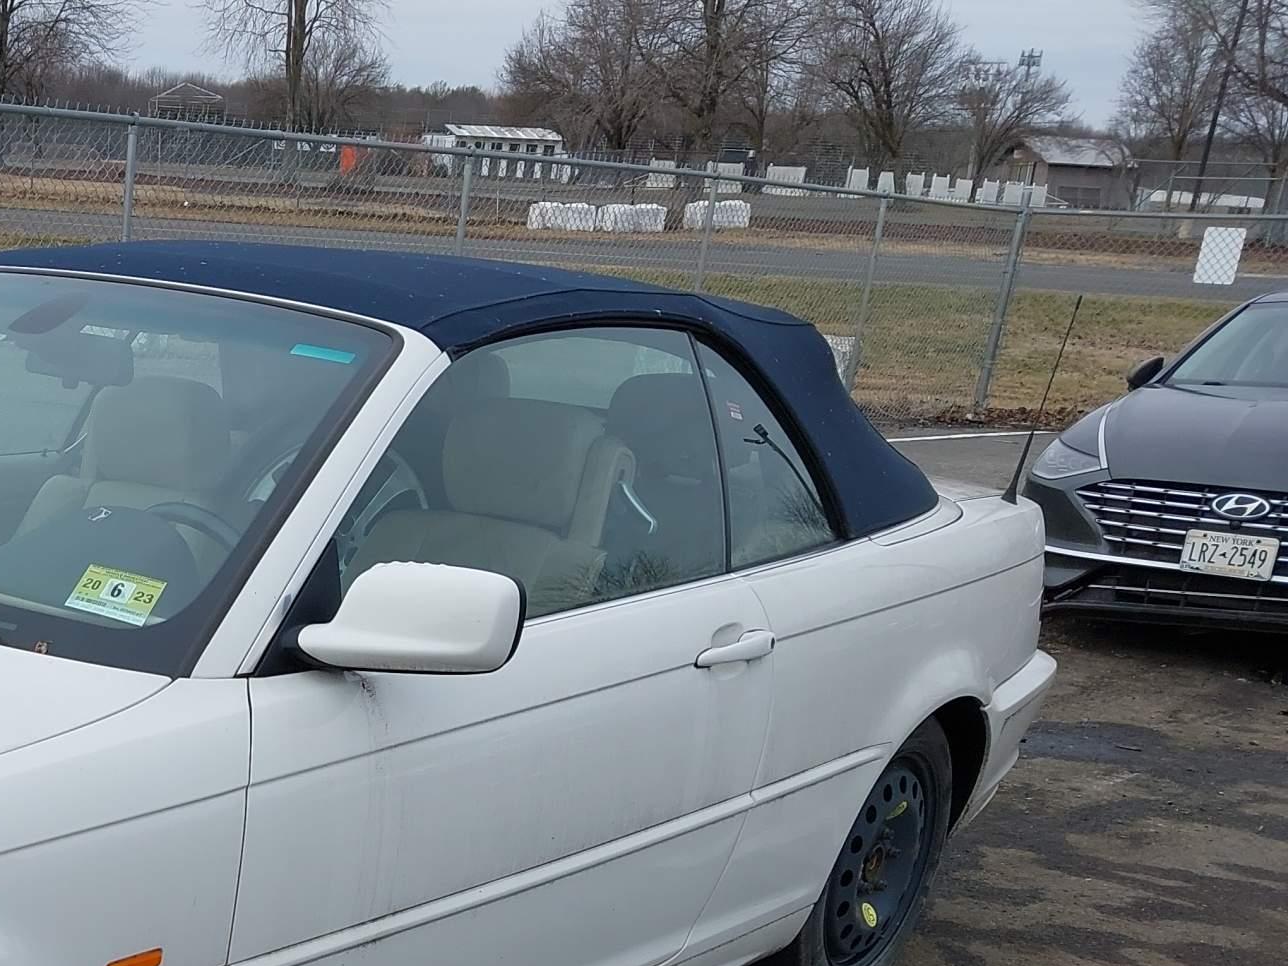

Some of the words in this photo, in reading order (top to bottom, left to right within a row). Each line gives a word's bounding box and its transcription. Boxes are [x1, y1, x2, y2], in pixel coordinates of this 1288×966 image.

[1208, 535, 1231, 544] NEW
[1232, 537, 1254, 547] YORK
[1188, 541, 1220, 564] LRZ
[1227, 545, 1269, 569] 2549
[82, 577, 102, 591] 20
[110, 582, 126, 599] 6
[133, 591, 155, 604] 23
